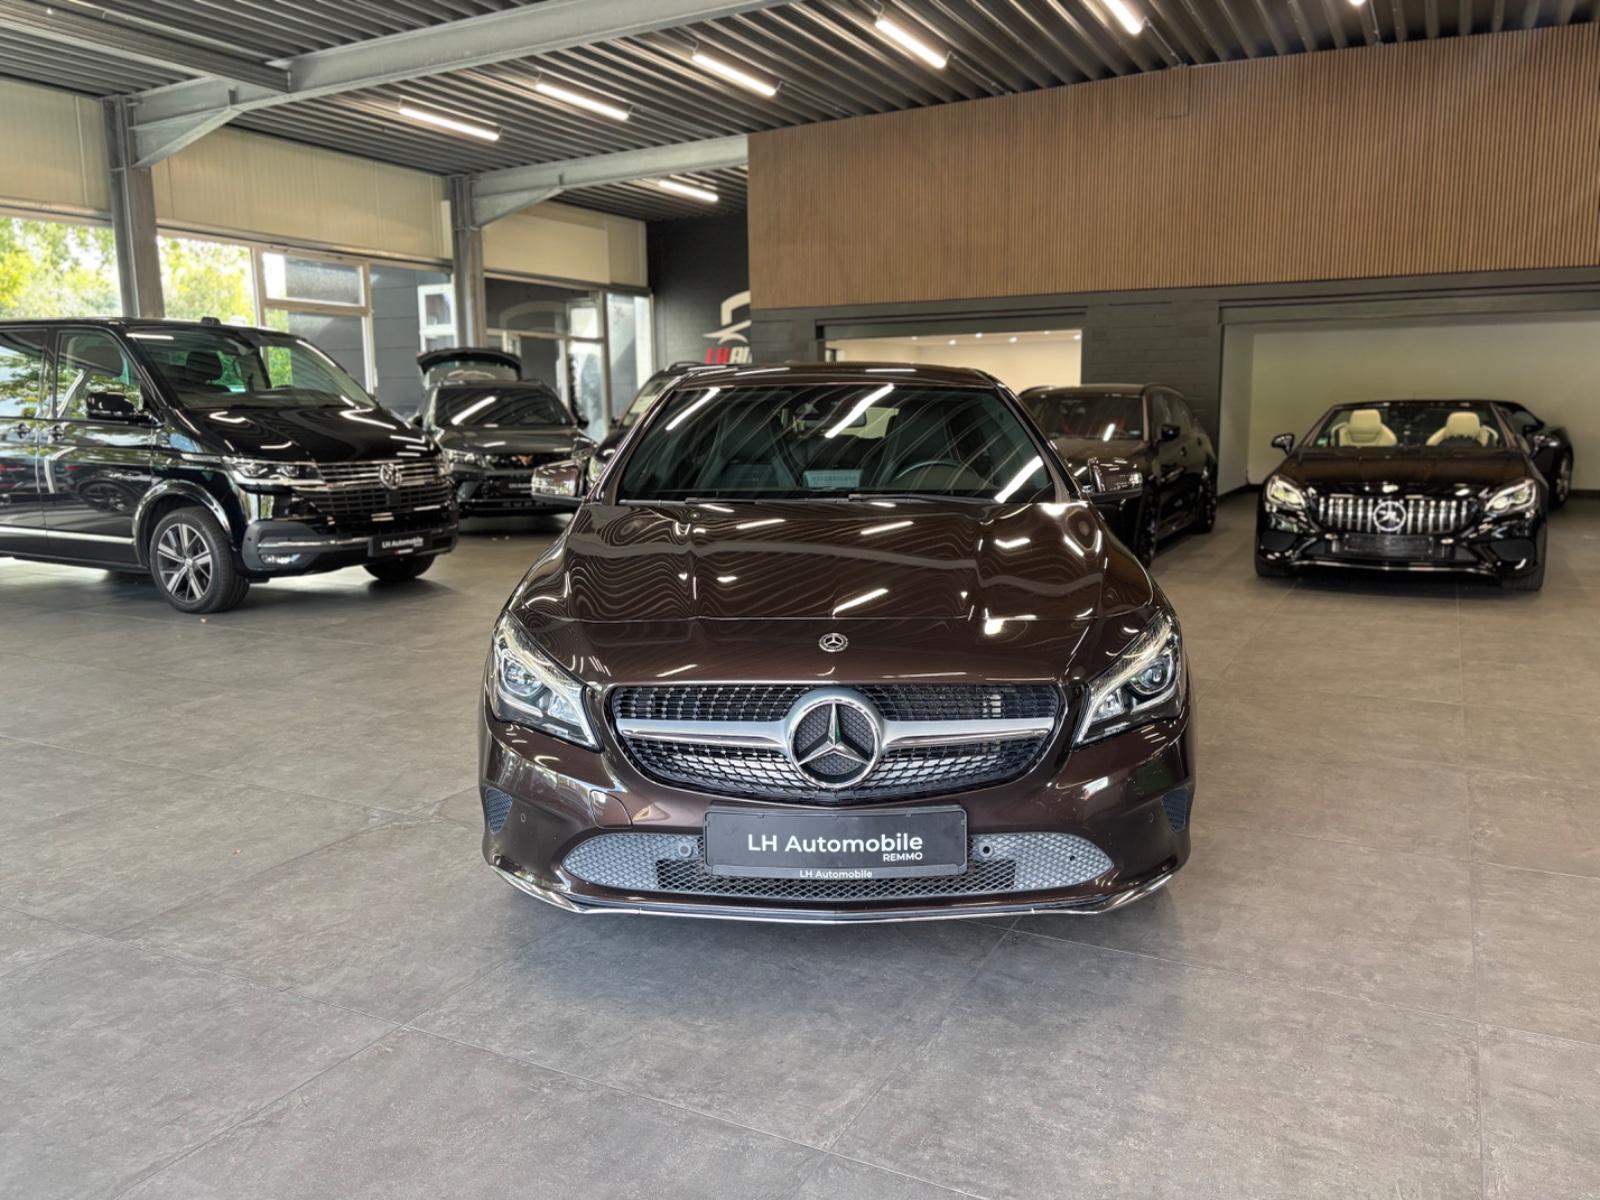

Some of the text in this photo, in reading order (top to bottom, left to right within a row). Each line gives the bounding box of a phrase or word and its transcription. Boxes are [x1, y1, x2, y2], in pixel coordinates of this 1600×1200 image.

[748, 833, 923, 852] LH Automobile
[883, 852, 923, 862] REMMO
[799, 869, 873, 879] LH Automobile
